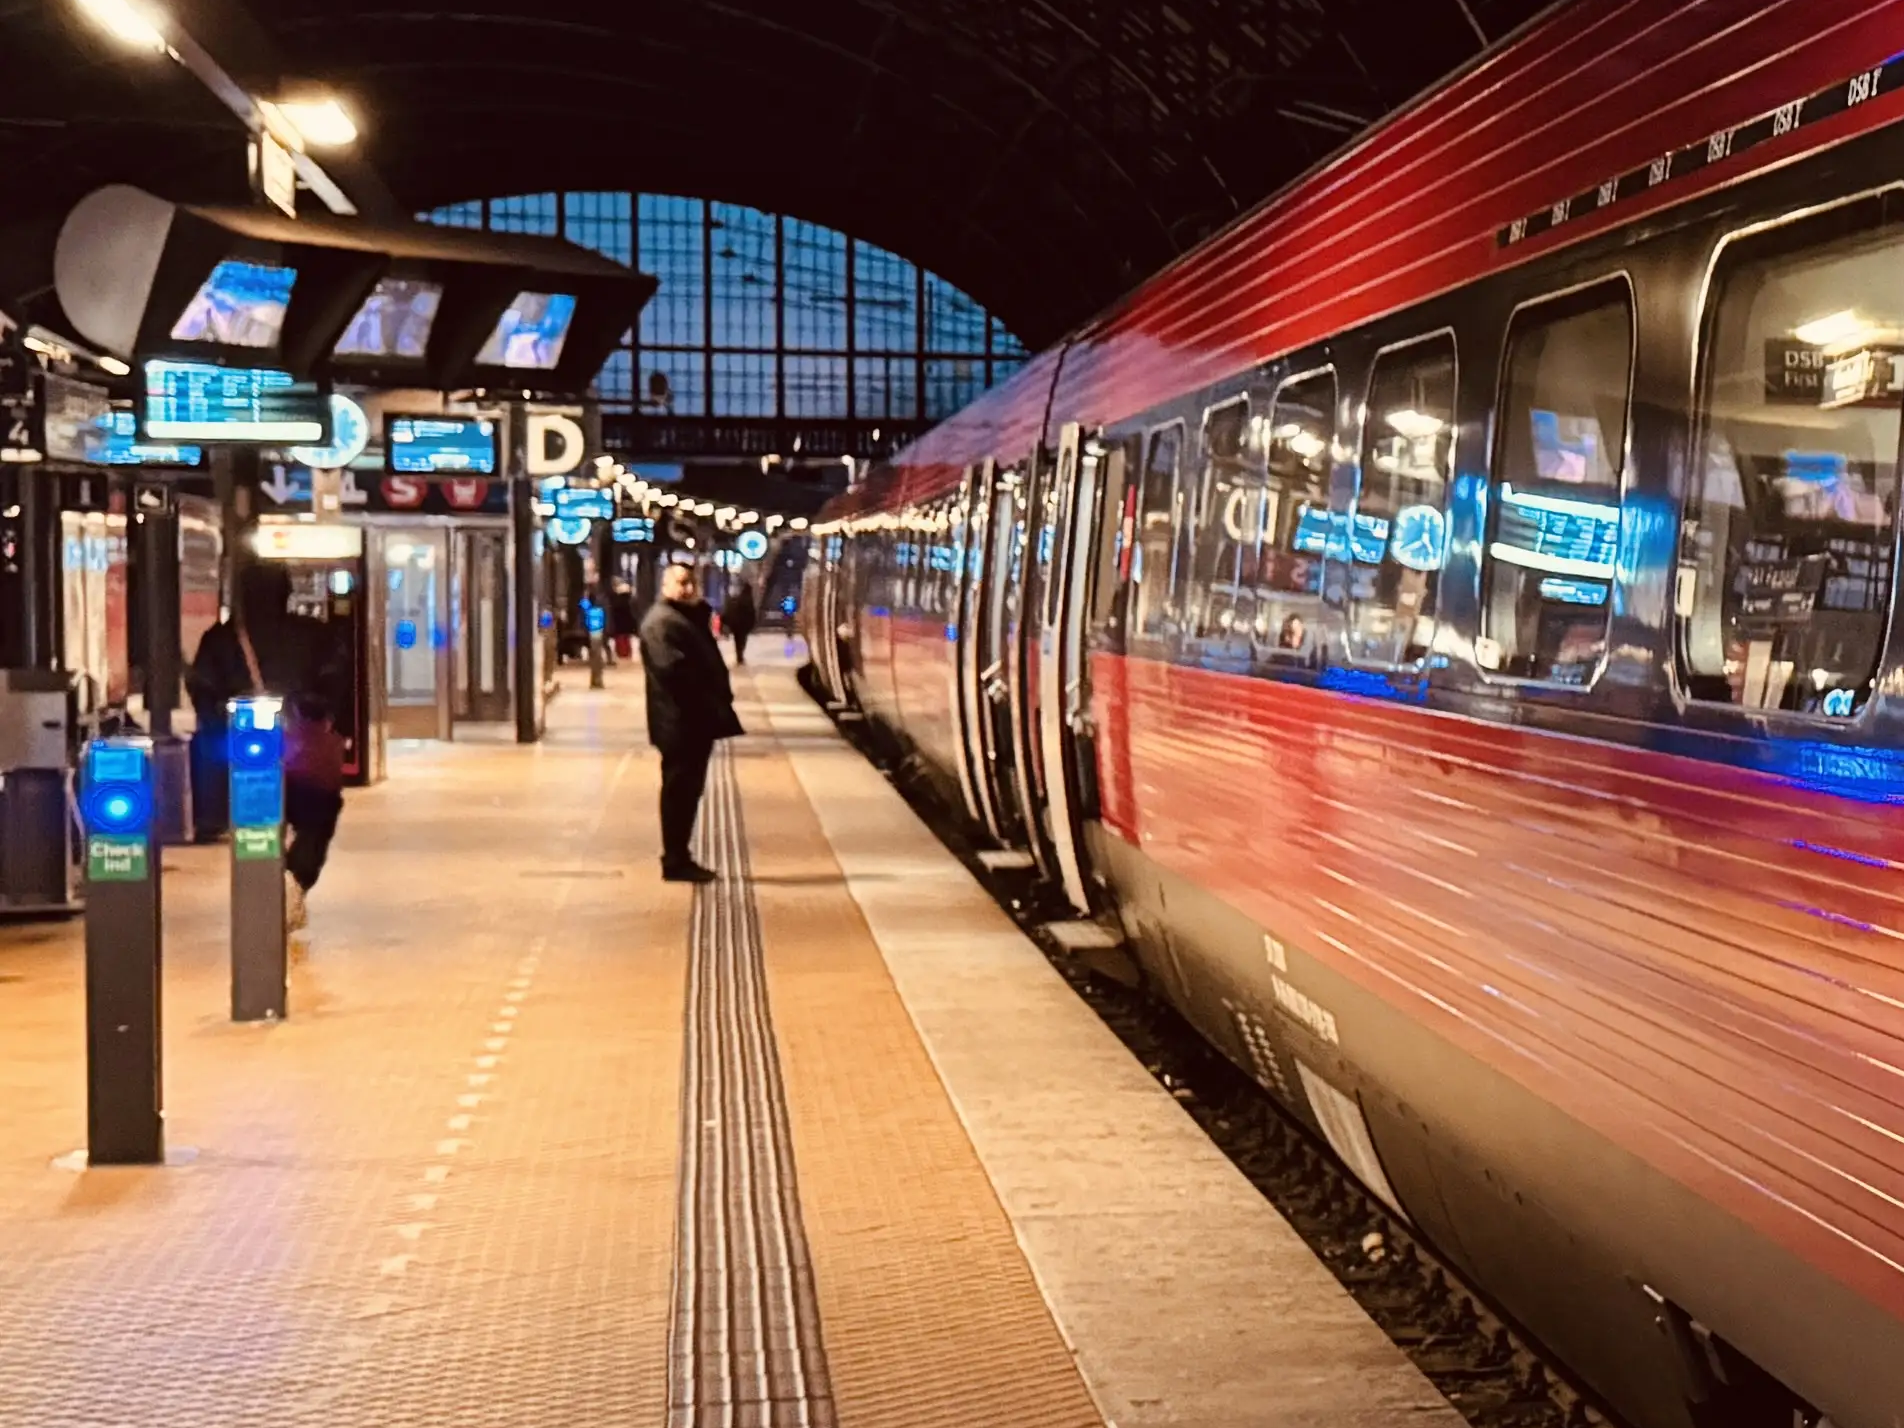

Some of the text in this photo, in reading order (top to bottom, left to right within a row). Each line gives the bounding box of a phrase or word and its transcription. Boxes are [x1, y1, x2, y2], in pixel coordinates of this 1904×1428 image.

[1848, 73, 1870, 106] DSB
[527, 415, 584, 474] D
[89, 841, 144, 858] Check
